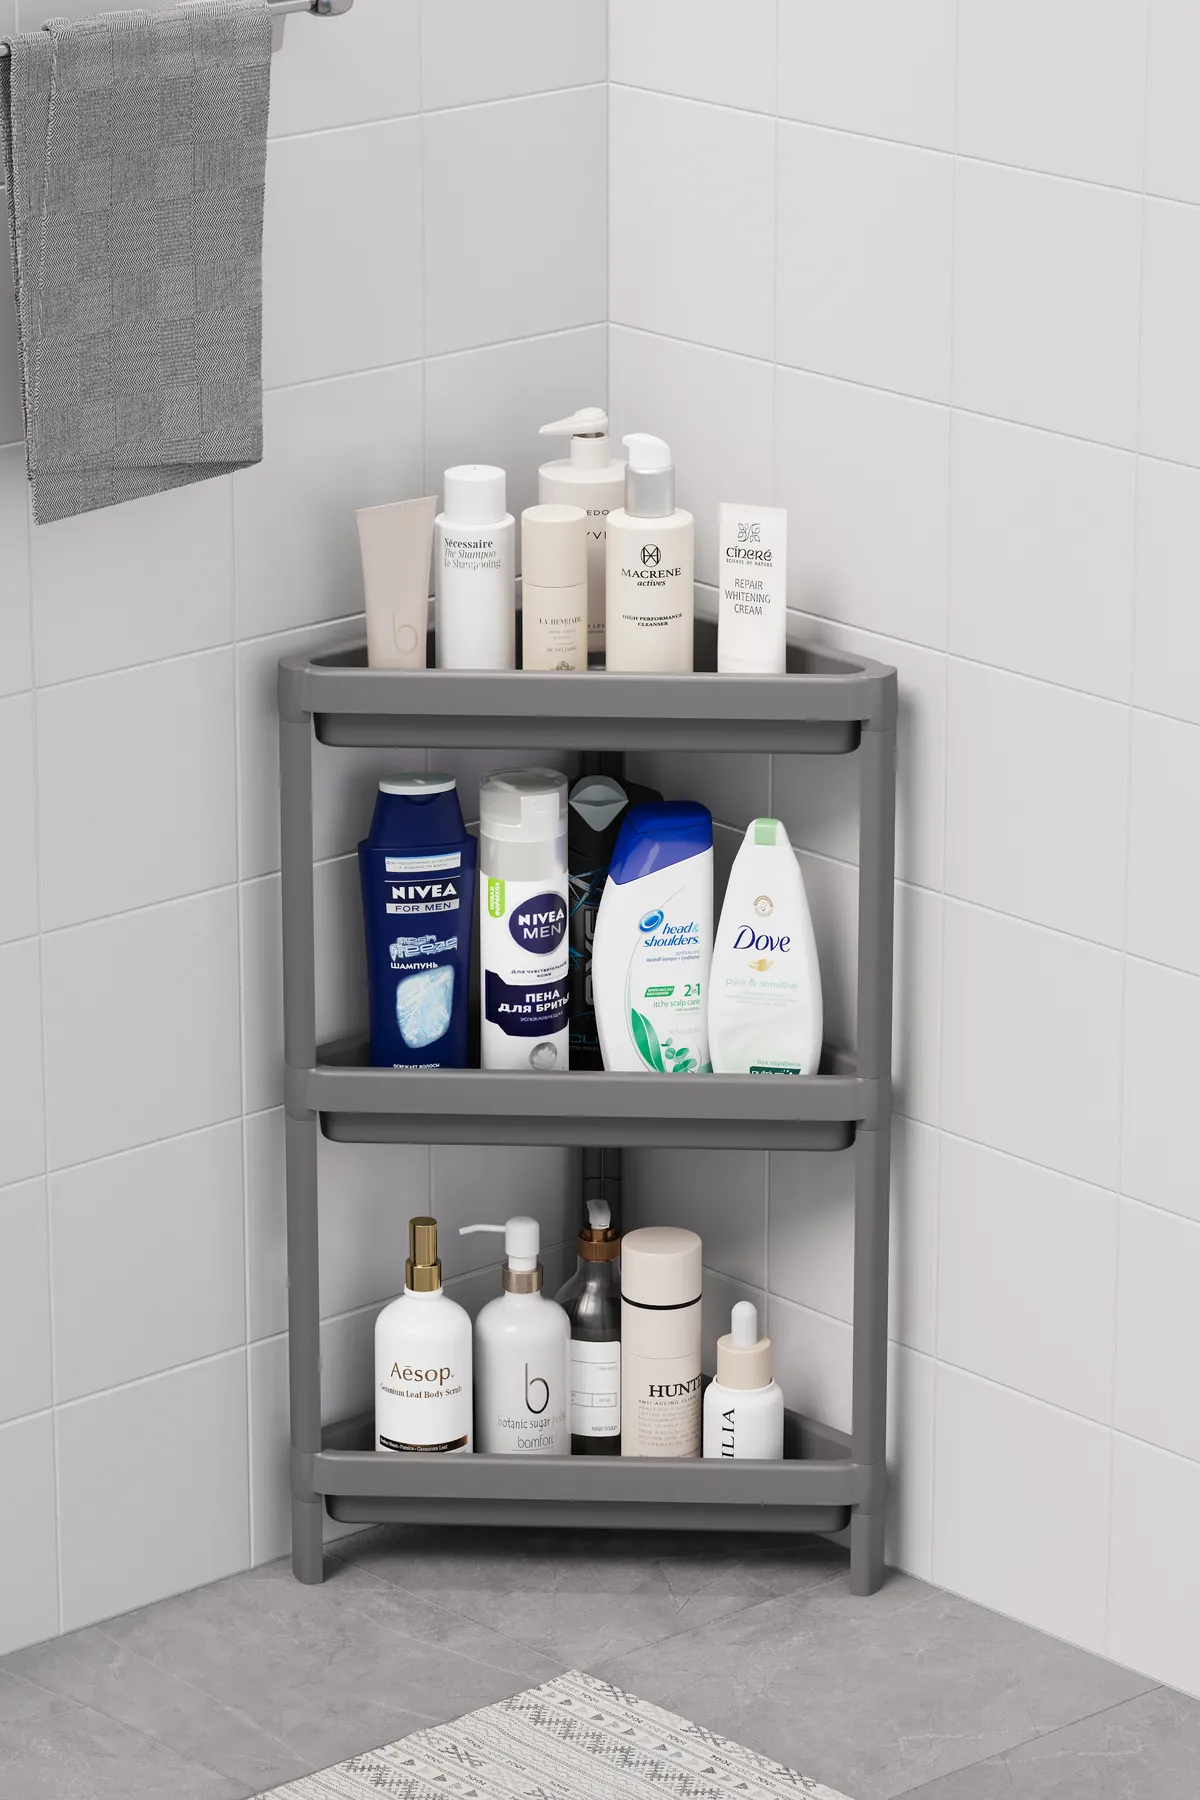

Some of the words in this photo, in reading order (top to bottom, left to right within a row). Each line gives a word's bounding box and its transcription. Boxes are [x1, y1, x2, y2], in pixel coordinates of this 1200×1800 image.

[444, 537, 494, 549] Nécessaire
[445, 548, 456, 558] The
[458, 549, 496, 560] Shampoo
[621, 567, 682, 579] MACRENE
[637, 579, 667, 587] actives
[734, 578, 763, 590] REPAIR
[725, 589, 771, 604] WHITENING
[734, 603, 763, 616] CREAM
[639, 612, 683, 622] PERFORMANCE
[392, 613, 419, 655] b
[392, 882, 457, 900] NIVEA
[425, 902, 451, 911] MEN
[518, 908, 565, 926] NIVEA
[523, 922, 561, 939] MEN
[643, 935, 700, 948] shoulders
[733, 925, 791, 952] Dove
[390, 962, 438, 970] ШАМПУНЬ
[725, 978, 746, 987] pure
[748, 978, 757, 987] &
[759, 980, 798, 990] sensitive
[525, 989, 560, 1003] ПЕНА
[498, 1003, 532, 1013] ДЛЯ
[653, 1000, 669, 1010] itchy
[670, 999, 686, 1007] scalp
[406, 1390, 422, 1399] Leaf
[424, 1390, 443, 1399] Body
[445, 1385, 462, 1396] Scrub
[525, 1362, 549, 1414] b
[497, 1414, 528, 1430] botanic
[529, 1418, 550, 1431] sugar
[722, 1408, 735, 1458] ILIA
